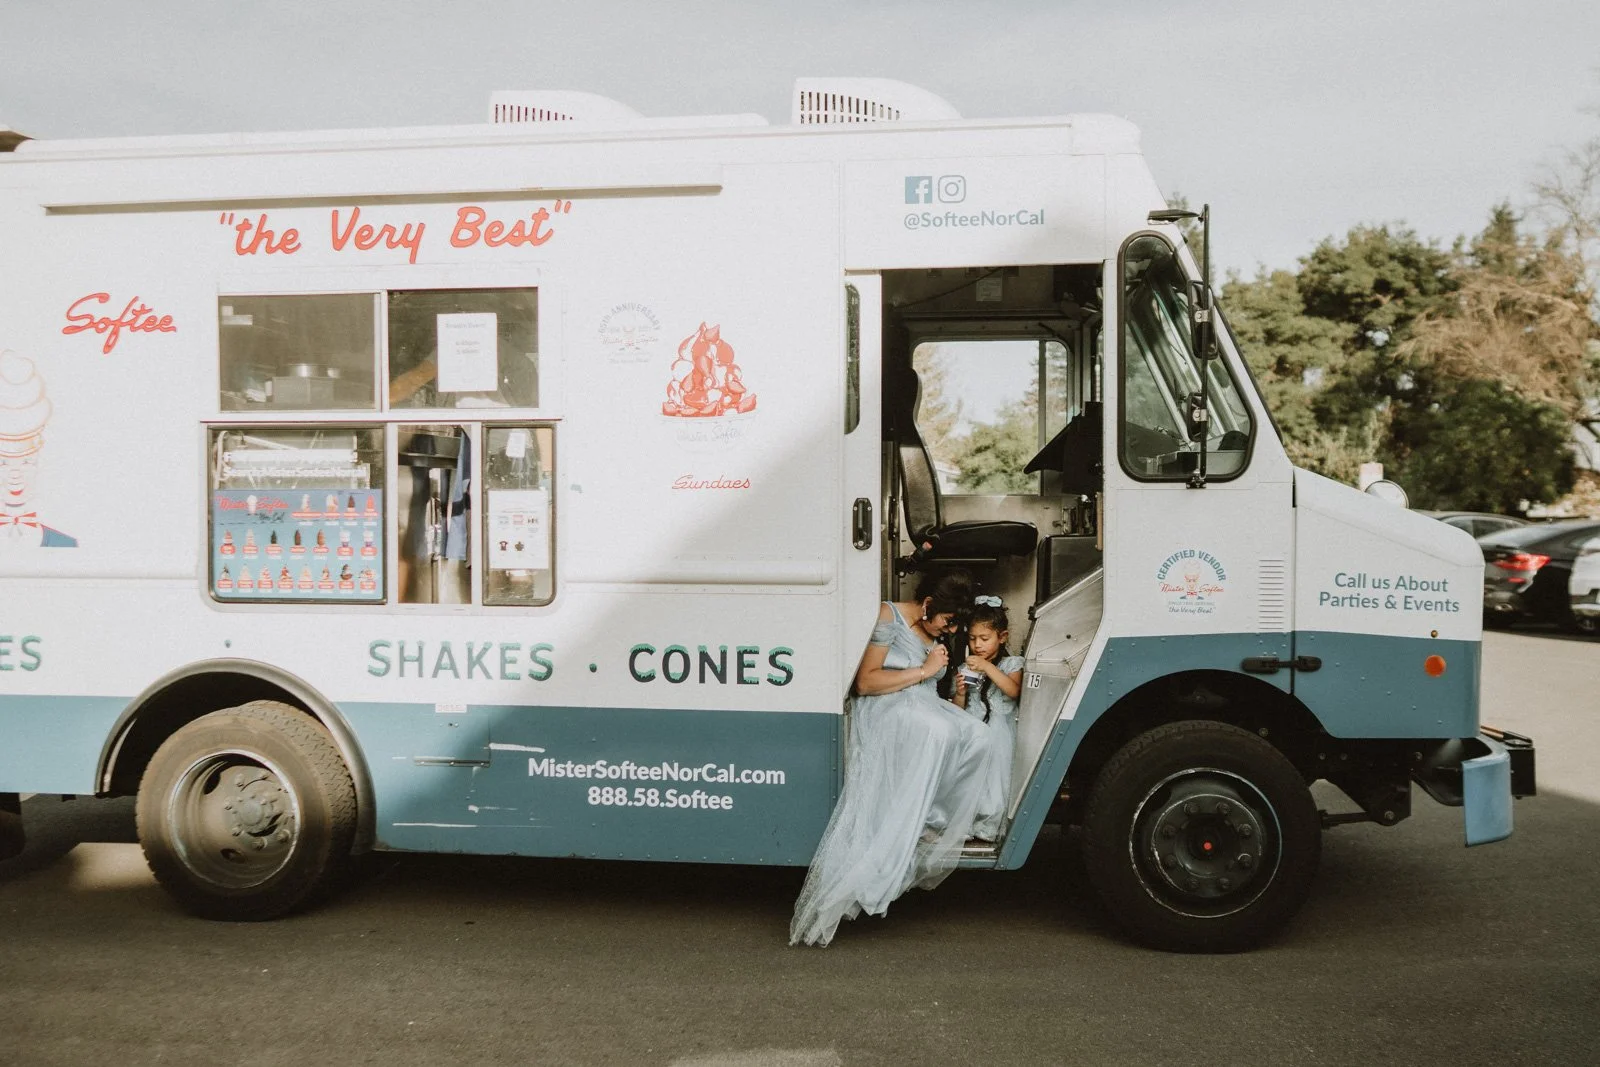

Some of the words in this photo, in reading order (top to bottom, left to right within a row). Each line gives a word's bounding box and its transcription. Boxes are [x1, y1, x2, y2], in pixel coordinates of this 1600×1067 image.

[904, 209, 1045, 230] @SofteeNorCal
[331, 206, 426, 264] Very
[62, 292, 177, 355] Softee
[672, 474, 750, 490] Sundaes
[1157, 549, 1195, 581] CERTIFIED
[1198, 550, 1227, 581] VENDOR
[1334, 572, 1366, 589] Call
[1371, 578, 1390, 589] us
[1394, 576, 1448, 593] About
[1319, 591, 1379, 609] Parties
[1384, 594, 1397, 610] &
[1403, 595, 1460, 613] Events
[367, 640, 554, 682] SHAKES
[628, 643, 795, 686] CONES
[1030, 674, 1041, 688] 15
[527, 757, 787, 786] MisterSofteeNorCal.com
[587, 786, 734, 811] 888.58.Softee
